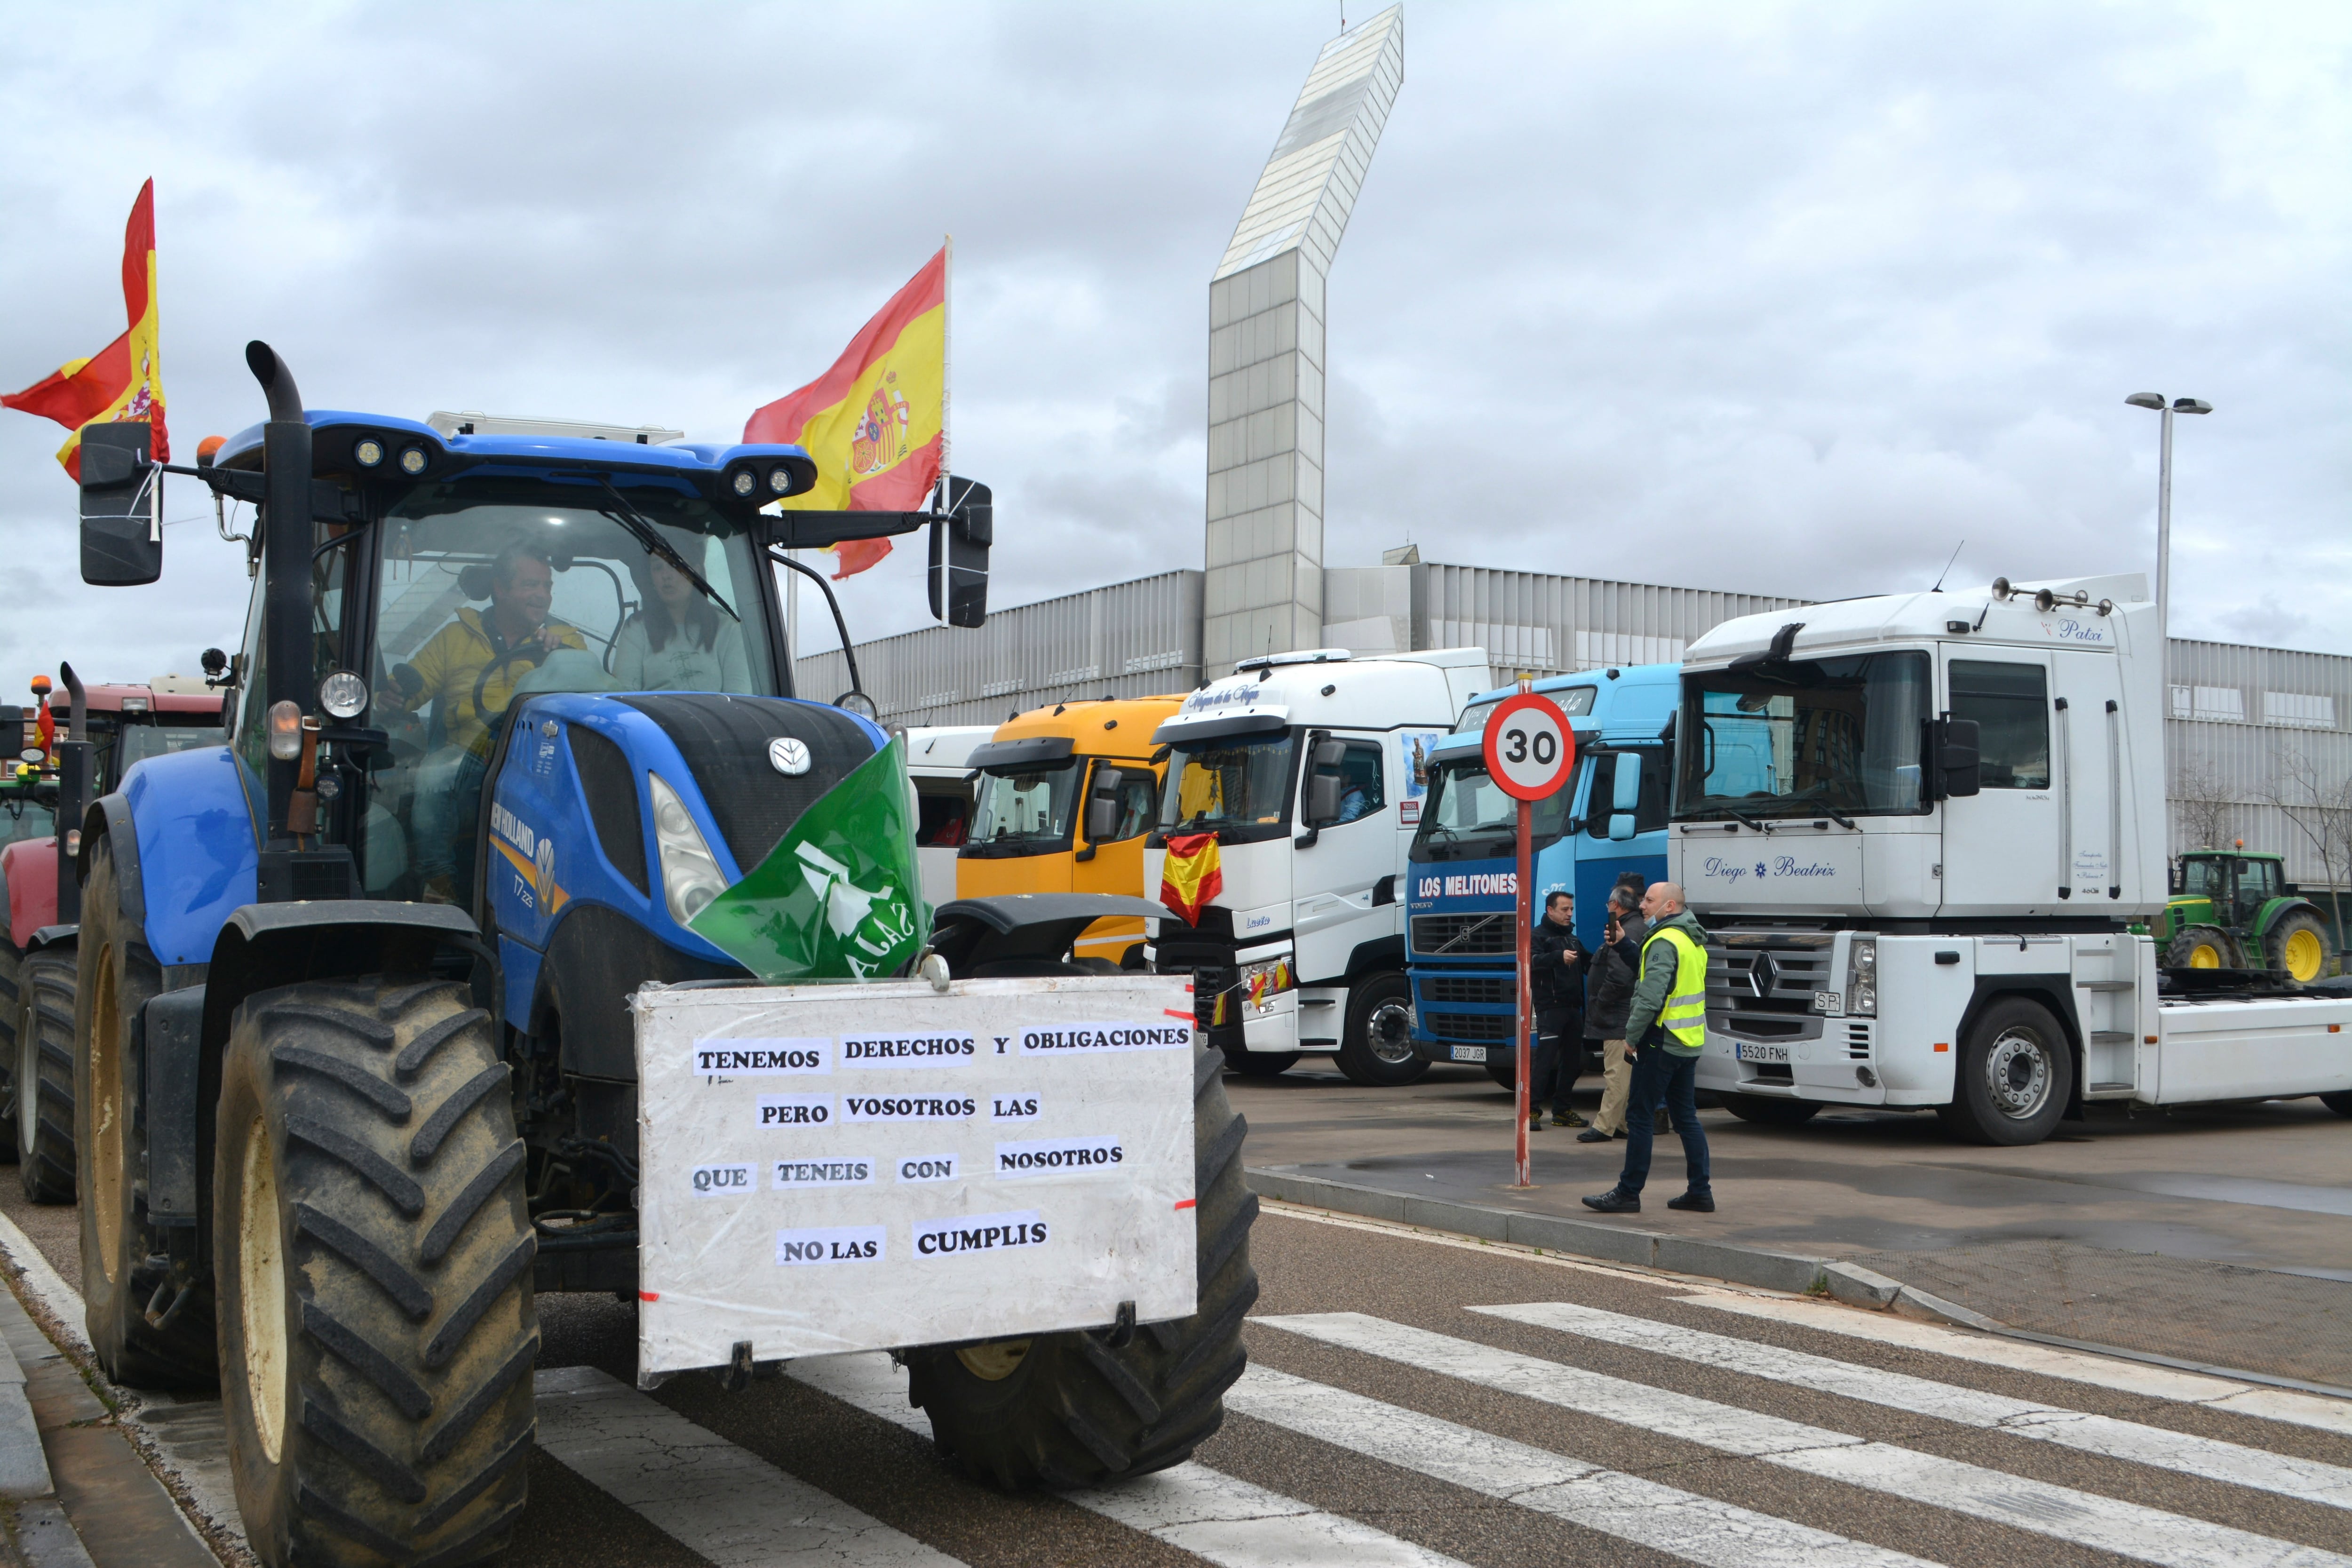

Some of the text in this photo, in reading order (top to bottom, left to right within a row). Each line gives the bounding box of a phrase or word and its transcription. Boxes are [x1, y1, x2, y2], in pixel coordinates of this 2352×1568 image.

[2058, 618, 2103, 642] Patxi
[1214, 691, 1223, 705] de
[1223, 690, 1232, 703] la
[1233, 684, 1260, 706] Vega
[1505, 728, 1556, 765] 30
[501, 808, 534, 858] HOLLAND
[1703, 855, 1836, 884] Diego Beatriz
[1419, 876, 1441, 898] LOS
[1445, 873, 1518, 896] MELITONES
[1817, 994, 1836, 1009] SP
[698, 1028, 1189, 1069] TENEMOS DERECHOS Y OBLIGACIONES
[1454, 1047, 1485, 1059] 2037 JGR
[1741, 1045, 1788, 1061] 5520 FNH
[762, 1098, 1038, 1123] PERO VOSOTROS LAS
[693, 1146, 1123, 1191] QUE TENEIS CON NOSOTROS
[783, 1222, 1047, 1261] NO LAS CUMPLIS
